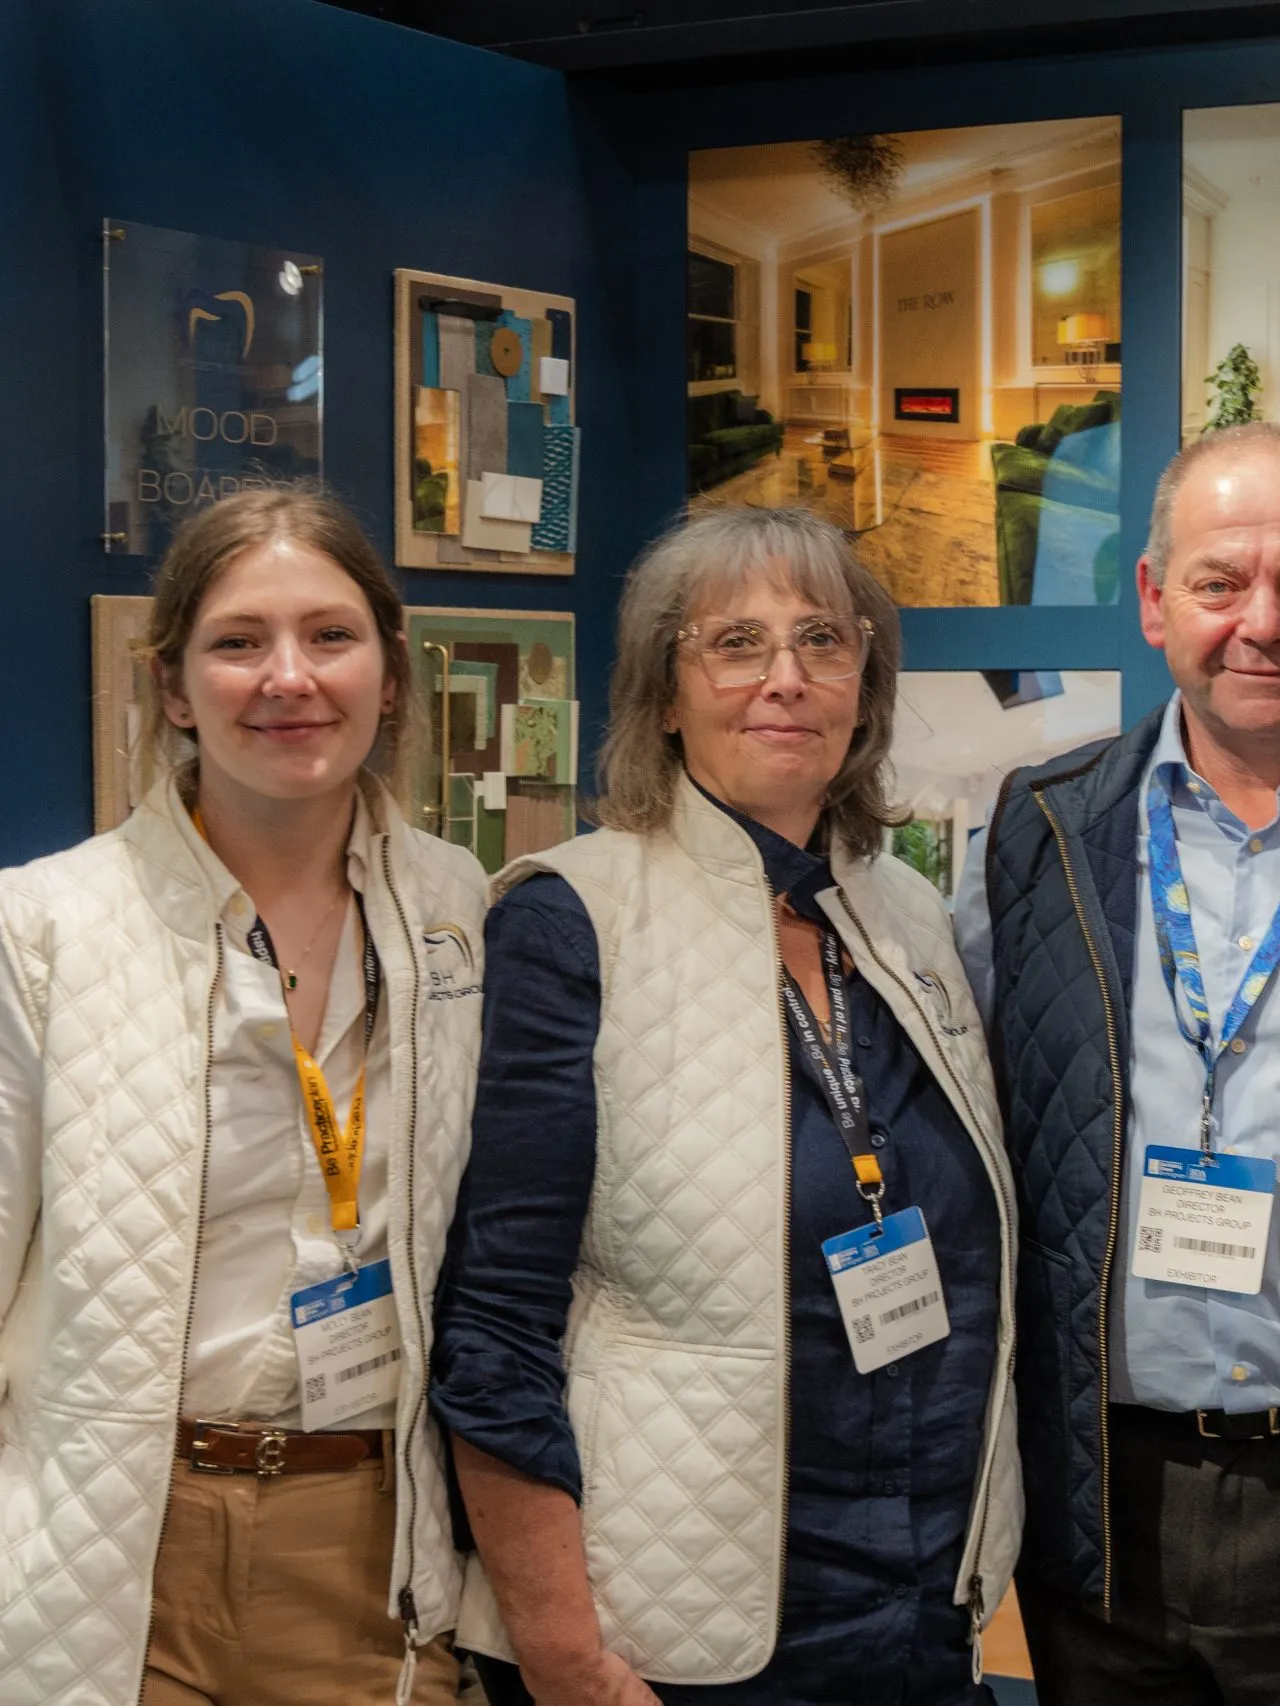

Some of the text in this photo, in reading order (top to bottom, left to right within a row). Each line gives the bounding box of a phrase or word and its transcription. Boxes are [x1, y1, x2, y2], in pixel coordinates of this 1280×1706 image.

[156, 404, 278, 446] MOOD
[1162, 1184, 1242, 1204] GEOFFREY BEAN
[1176, 1199, 1226, 1214] DIRECTOR
[1148, 1207, 1252, 1230] BH PROJECTS GROUP
[888, 1251, 908, 1264] BEAN
[864, 1280, 903, 1303] PROJECTS
[904, 1268, 929, 1287] GROUP
[869, 1265, 908, 1287] DIRECTOR
[1167, 1268, 1217, 1283] EXHIBITOR
[320, 1335, 363, 1359] PROJECTS
[365, 1325, 392, 1342] GROUP
[328, 1321, 369, 1344] DIRECTOR
